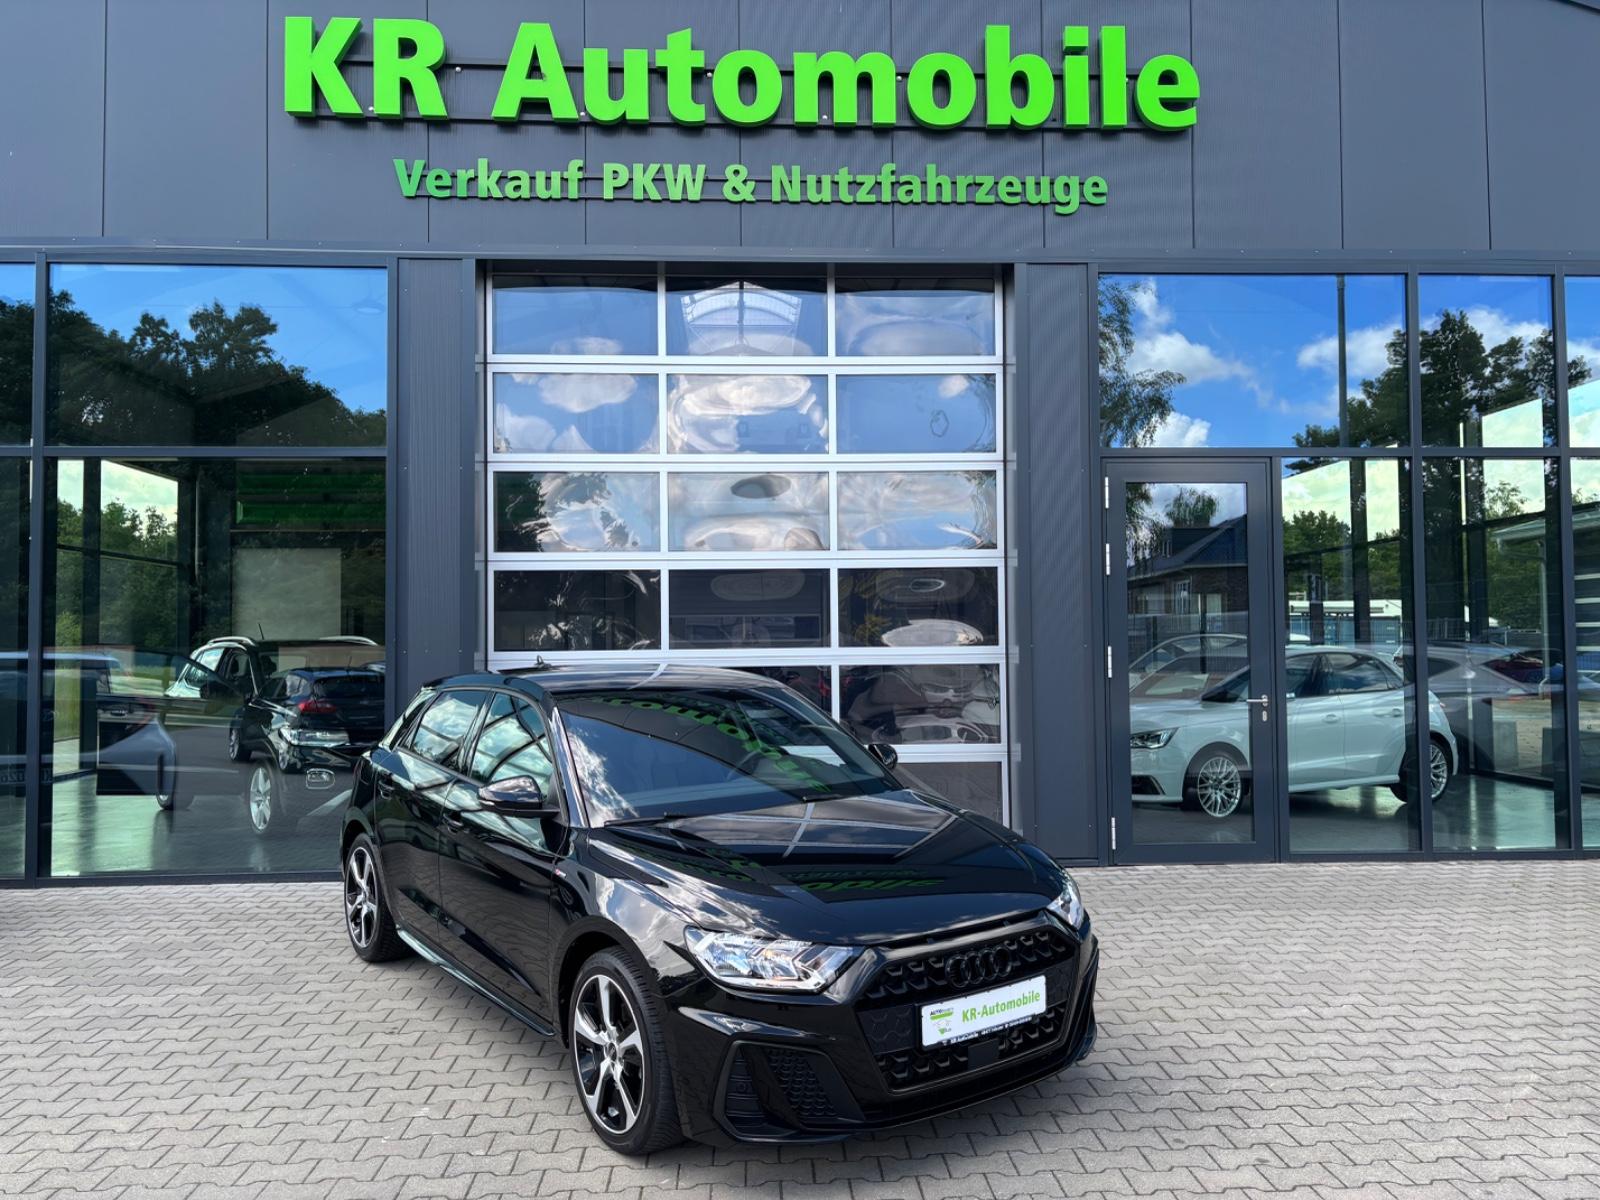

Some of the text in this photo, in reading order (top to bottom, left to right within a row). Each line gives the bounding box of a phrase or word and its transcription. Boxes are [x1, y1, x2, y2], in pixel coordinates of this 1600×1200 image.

[284, 17, 1200, 130] KR Automobile
[393, 158, 1108, 215] Verkauf PKW & Nutzfahrzeuge
[962, 991, 1040, 1022] KR-Automobile
